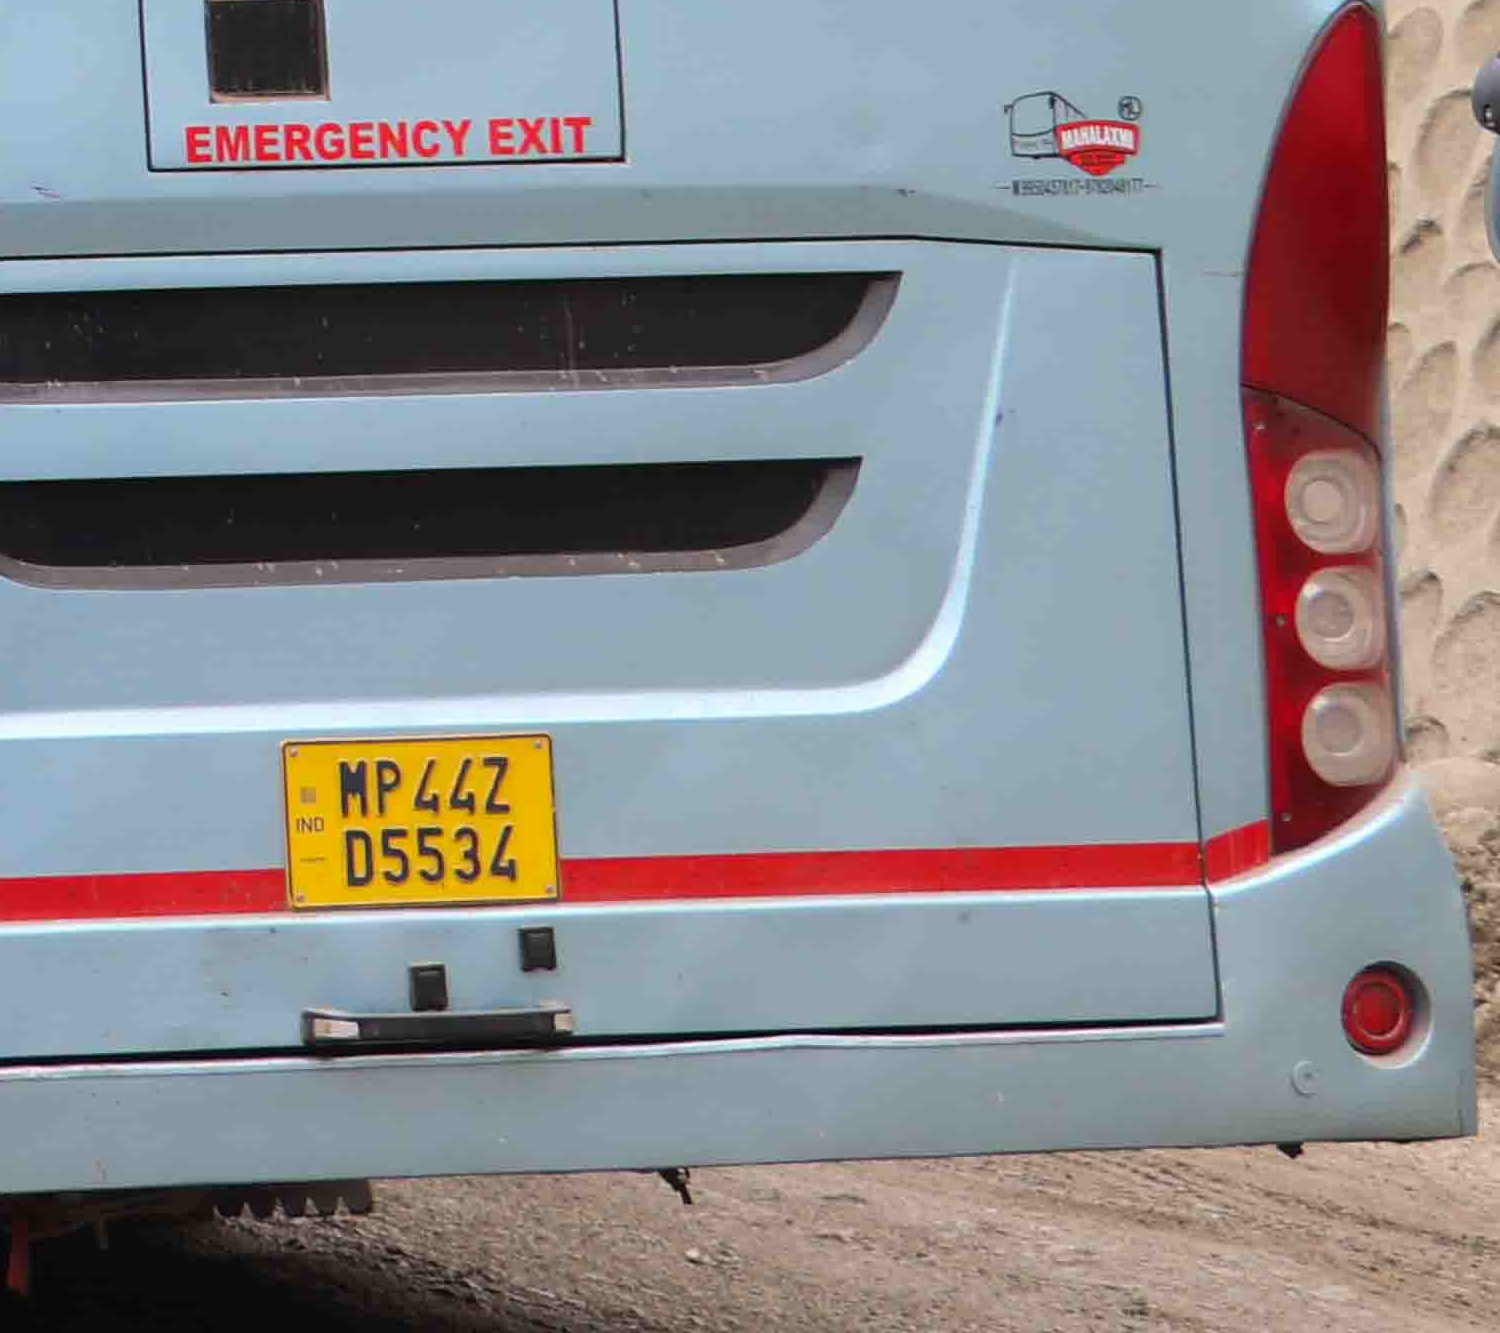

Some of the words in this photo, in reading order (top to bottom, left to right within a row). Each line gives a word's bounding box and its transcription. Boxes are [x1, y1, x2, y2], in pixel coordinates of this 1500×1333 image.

[184, 119, 472, 164] EMERGENCY
[488, 116, 592, 155] EXIT
[296, 816, 325, 833] IND
[344, 825, 517, 887] D5534
